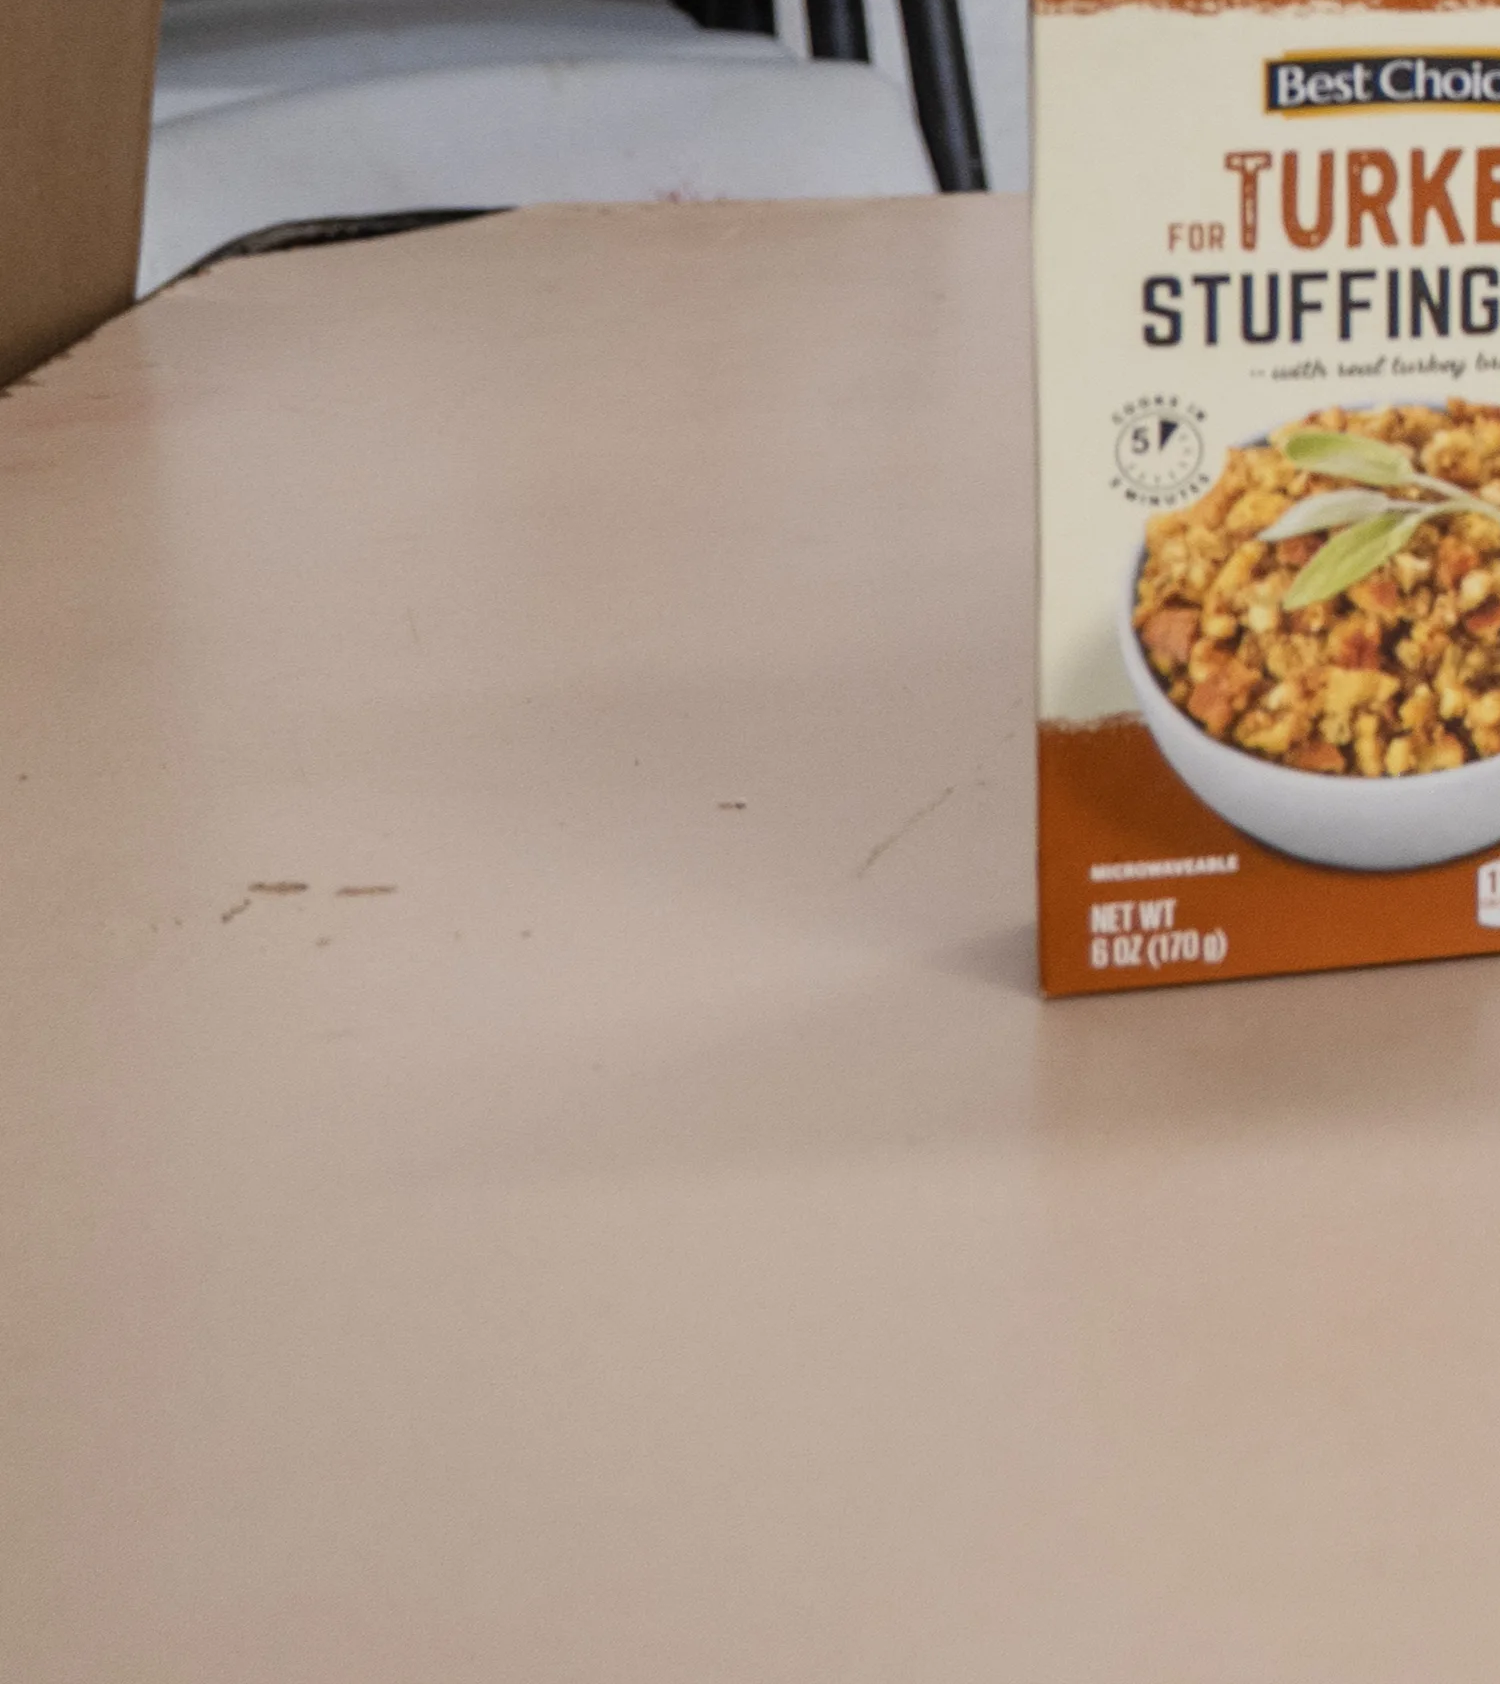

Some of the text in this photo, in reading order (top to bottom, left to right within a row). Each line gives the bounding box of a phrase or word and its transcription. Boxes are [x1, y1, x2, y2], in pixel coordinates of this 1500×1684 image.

[1275, 62, 1373, 108] Best
[1167, 222, 1226, 254] FOR
[1270, 355, 1329, 382] with
[1390, 351, 1468, 381] turkey
[1130, 425, 1150, 456] 5
[1089, 897, 1178, 934] NET WT
[1112, 932, 1143, 967] OZ
